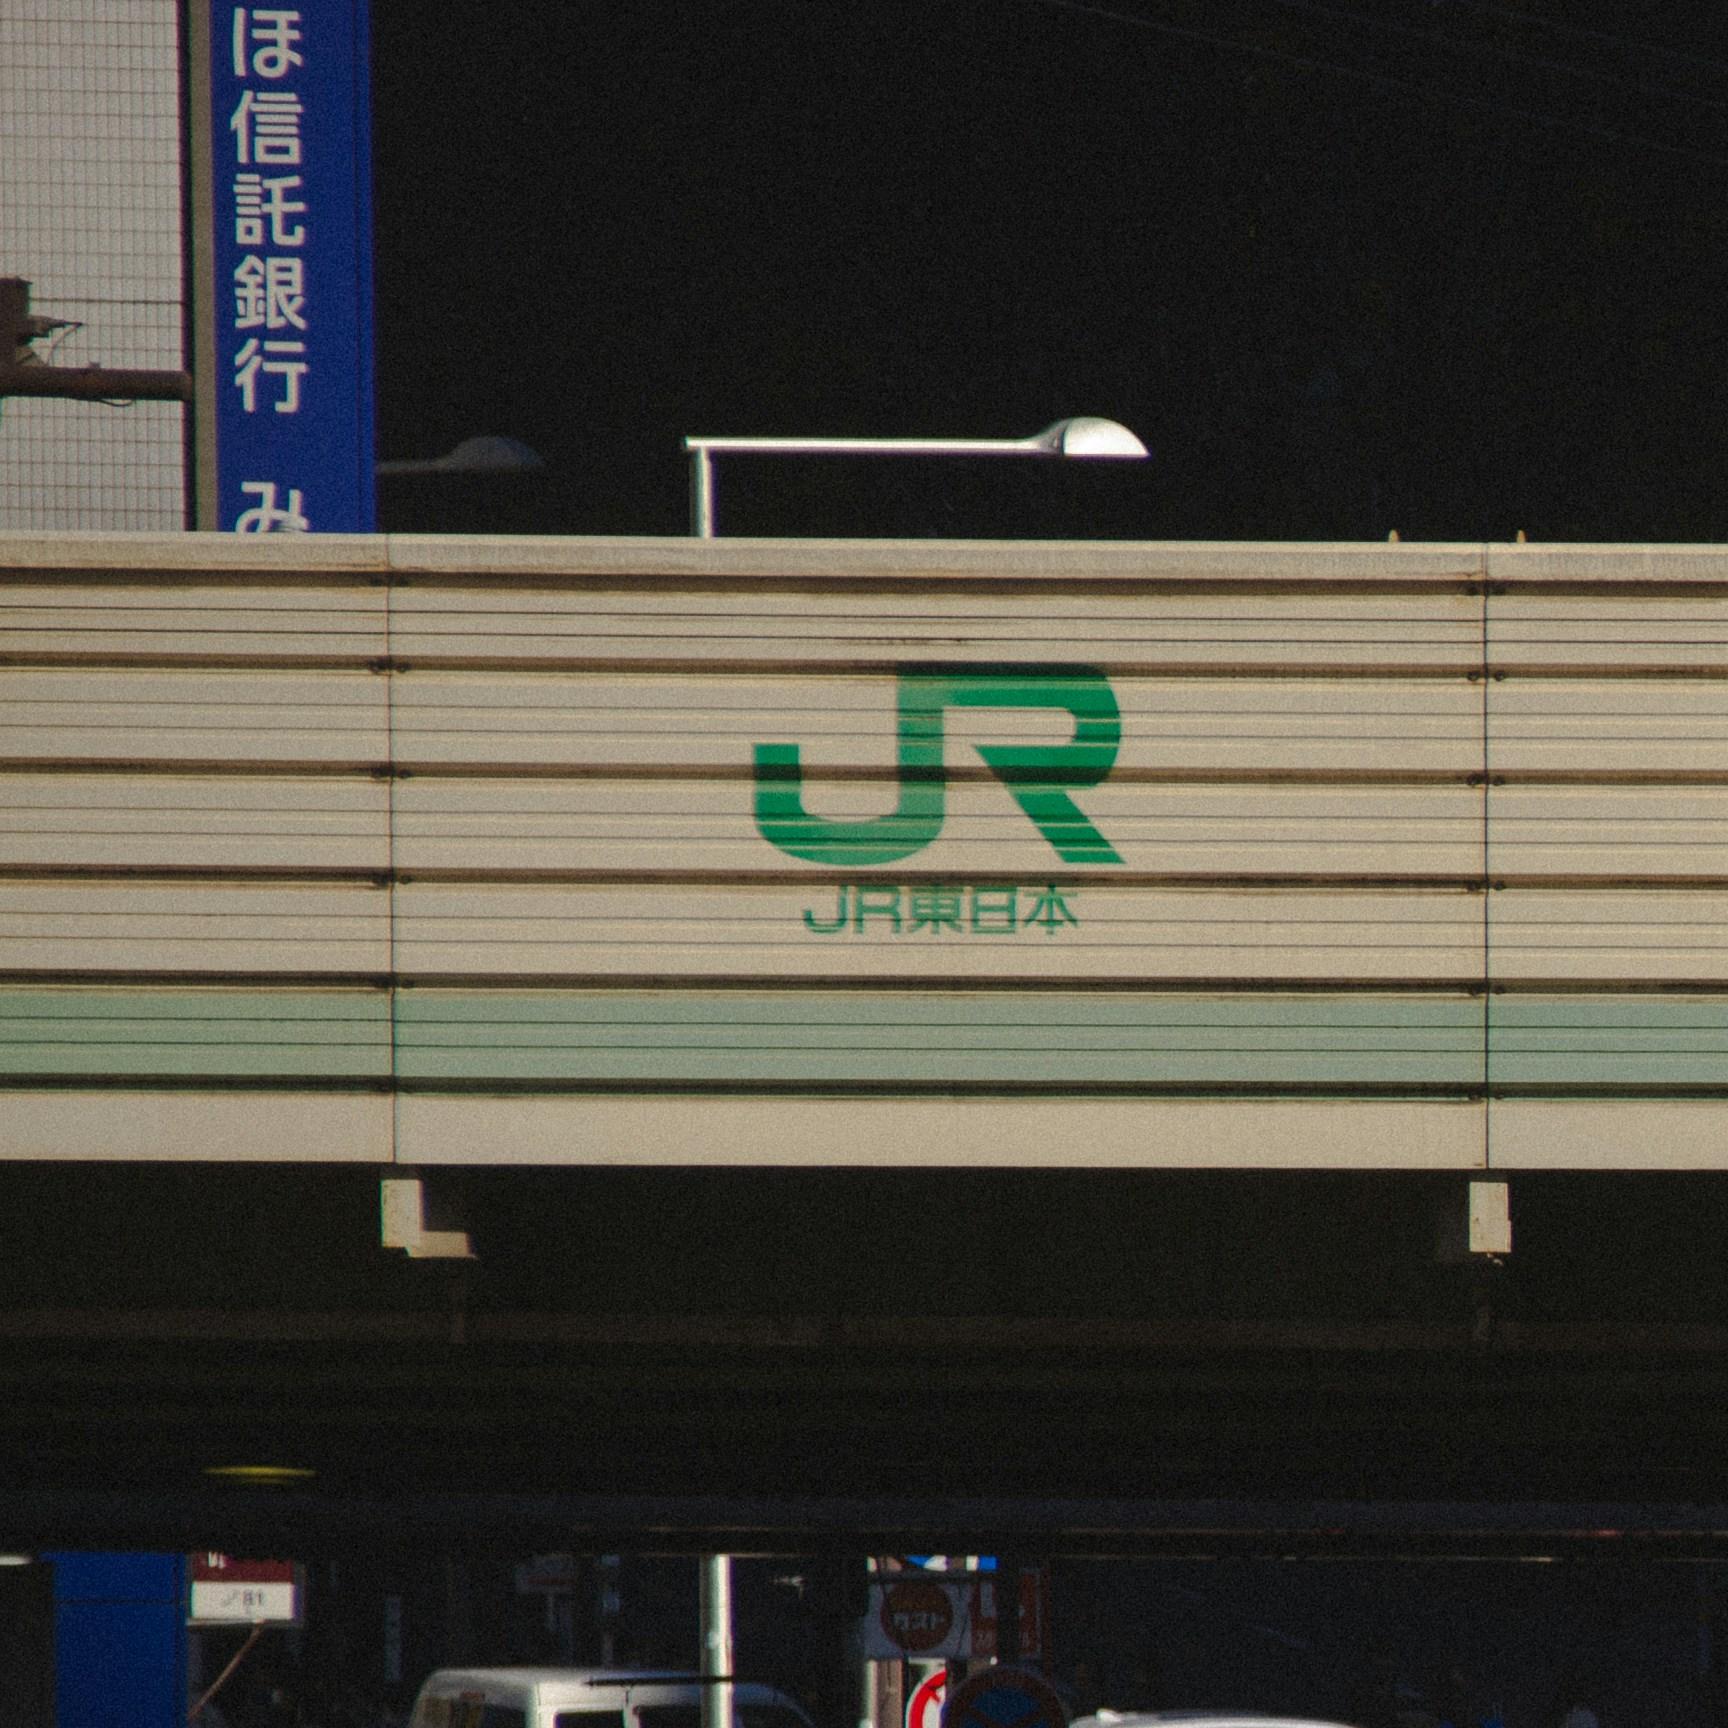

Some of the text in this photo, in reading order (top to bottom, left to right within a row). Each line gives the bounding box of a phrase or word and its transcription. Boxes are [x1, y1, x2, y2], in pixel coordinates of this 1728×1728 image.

[230, 7, 308, 414] ほ信託銀行
[752, 662, 1126, 866] JR
[803, 884, 1080, 936] JR東日本
